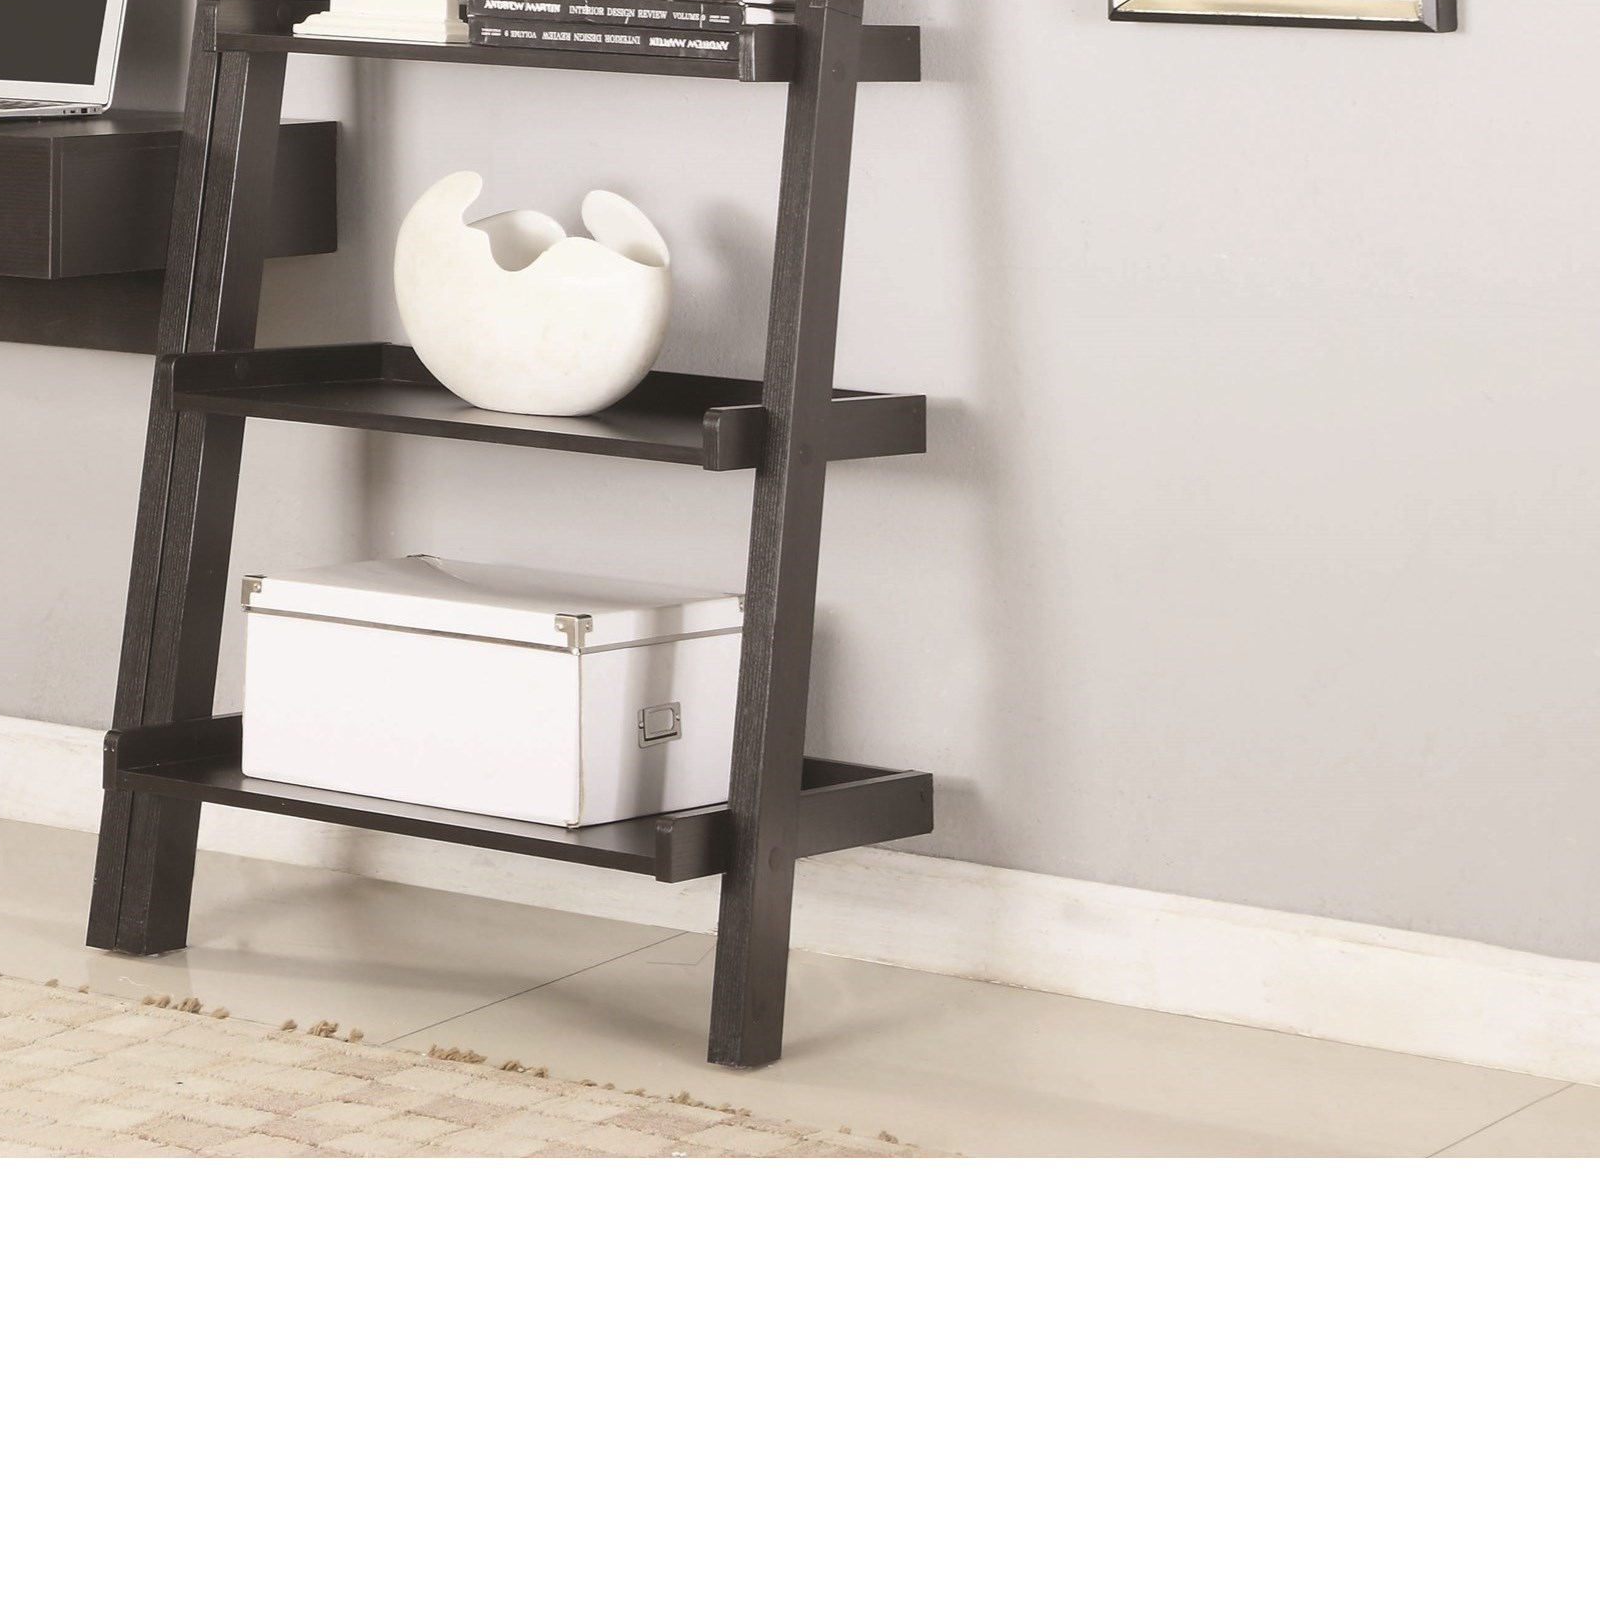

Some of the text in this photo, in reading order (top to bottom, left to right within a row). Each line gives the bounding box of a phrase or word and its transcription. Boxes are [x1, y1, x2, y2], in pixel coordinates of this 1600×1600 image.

[484, 0, 525, 11] ANDREW
[524, 2, 561, 13] MARTIN
[568, 5, 605, 16] INTERIOR
[606, 7, 636, 17] DESIGN
[637, 9, 668, 19] REVIEW
[672, 11, 700, 21] VOLUME
[510, 30, 537, 39] VOLUME
[542, 31, 571, 41] REVIEW
[573, 32, 602, 43] DESIGN
[604, 34, 641, 45] INTERIOR
[649, 37, 687, 48] MARTIN
[687, 39, 730, 50] ANDREW
